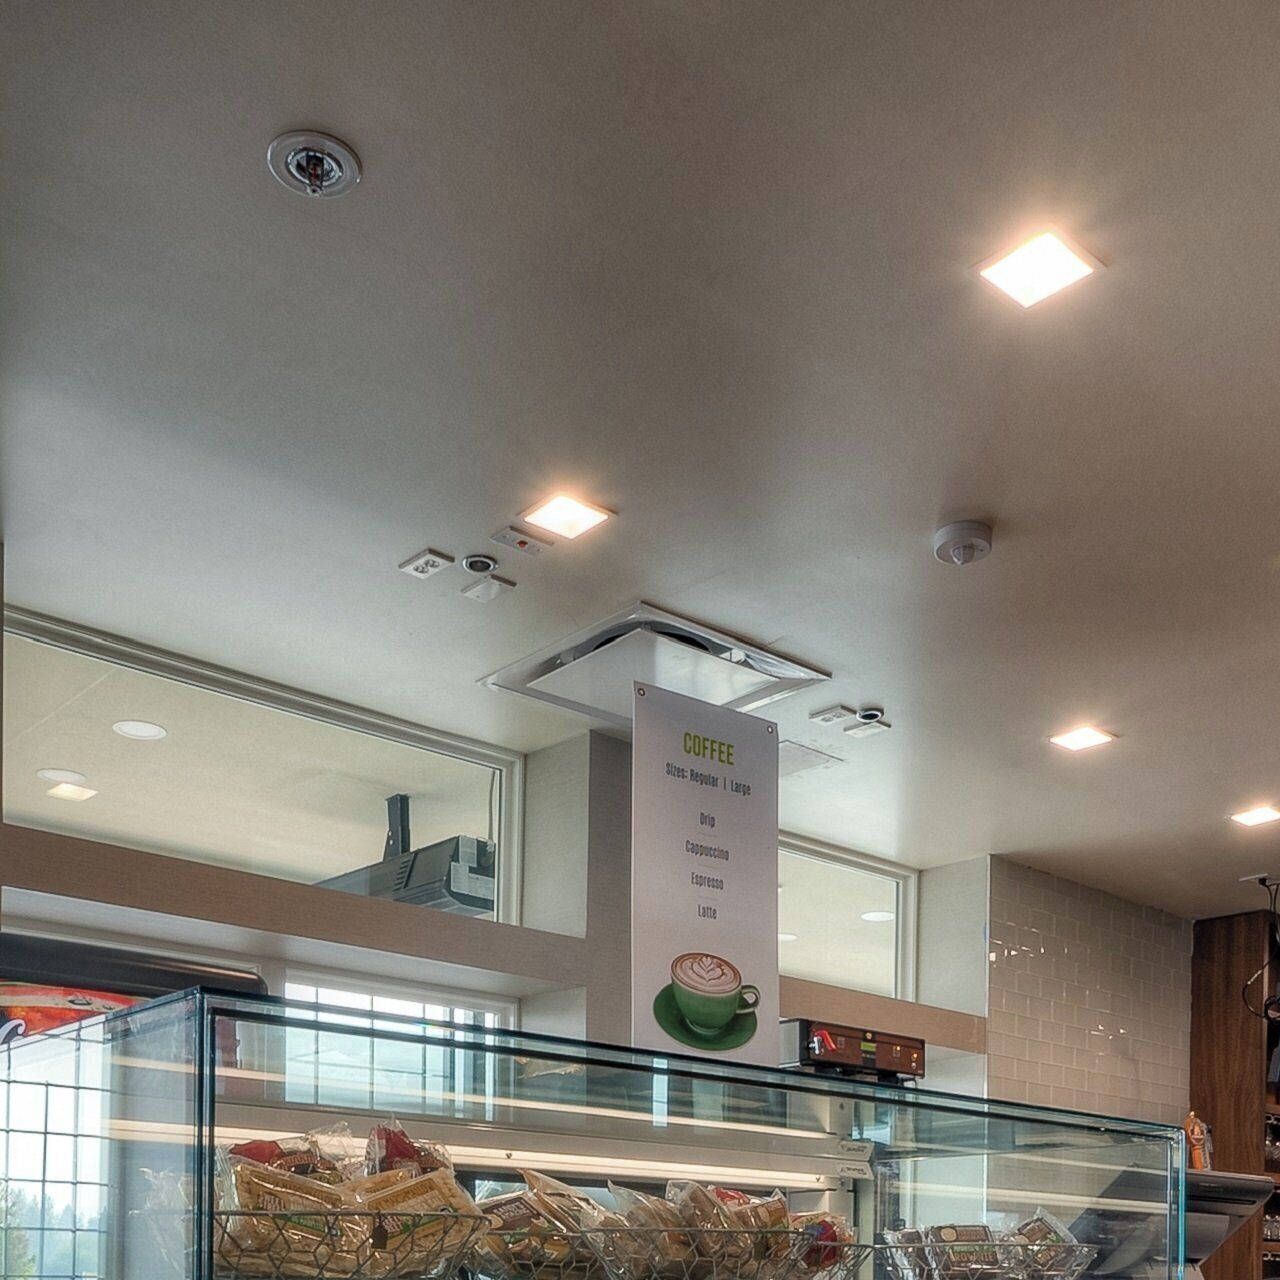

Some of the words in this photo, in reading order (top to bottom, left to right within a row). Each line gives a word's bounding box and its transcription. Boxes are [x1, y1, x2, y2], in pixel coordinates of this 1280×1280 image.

[683, 731, 735, 766] COFFEE
[665, 762, 688, 780] Sizes:
[689, 769, 719, 790] Regular
[730, 779, 751, 796] Large
[700, 812, 716, 829] Drip
[685, 840, 729, 862] Cappuccino
[691, 871, 724, 891] Espresso
[698, 904, 717, 920] Latte
